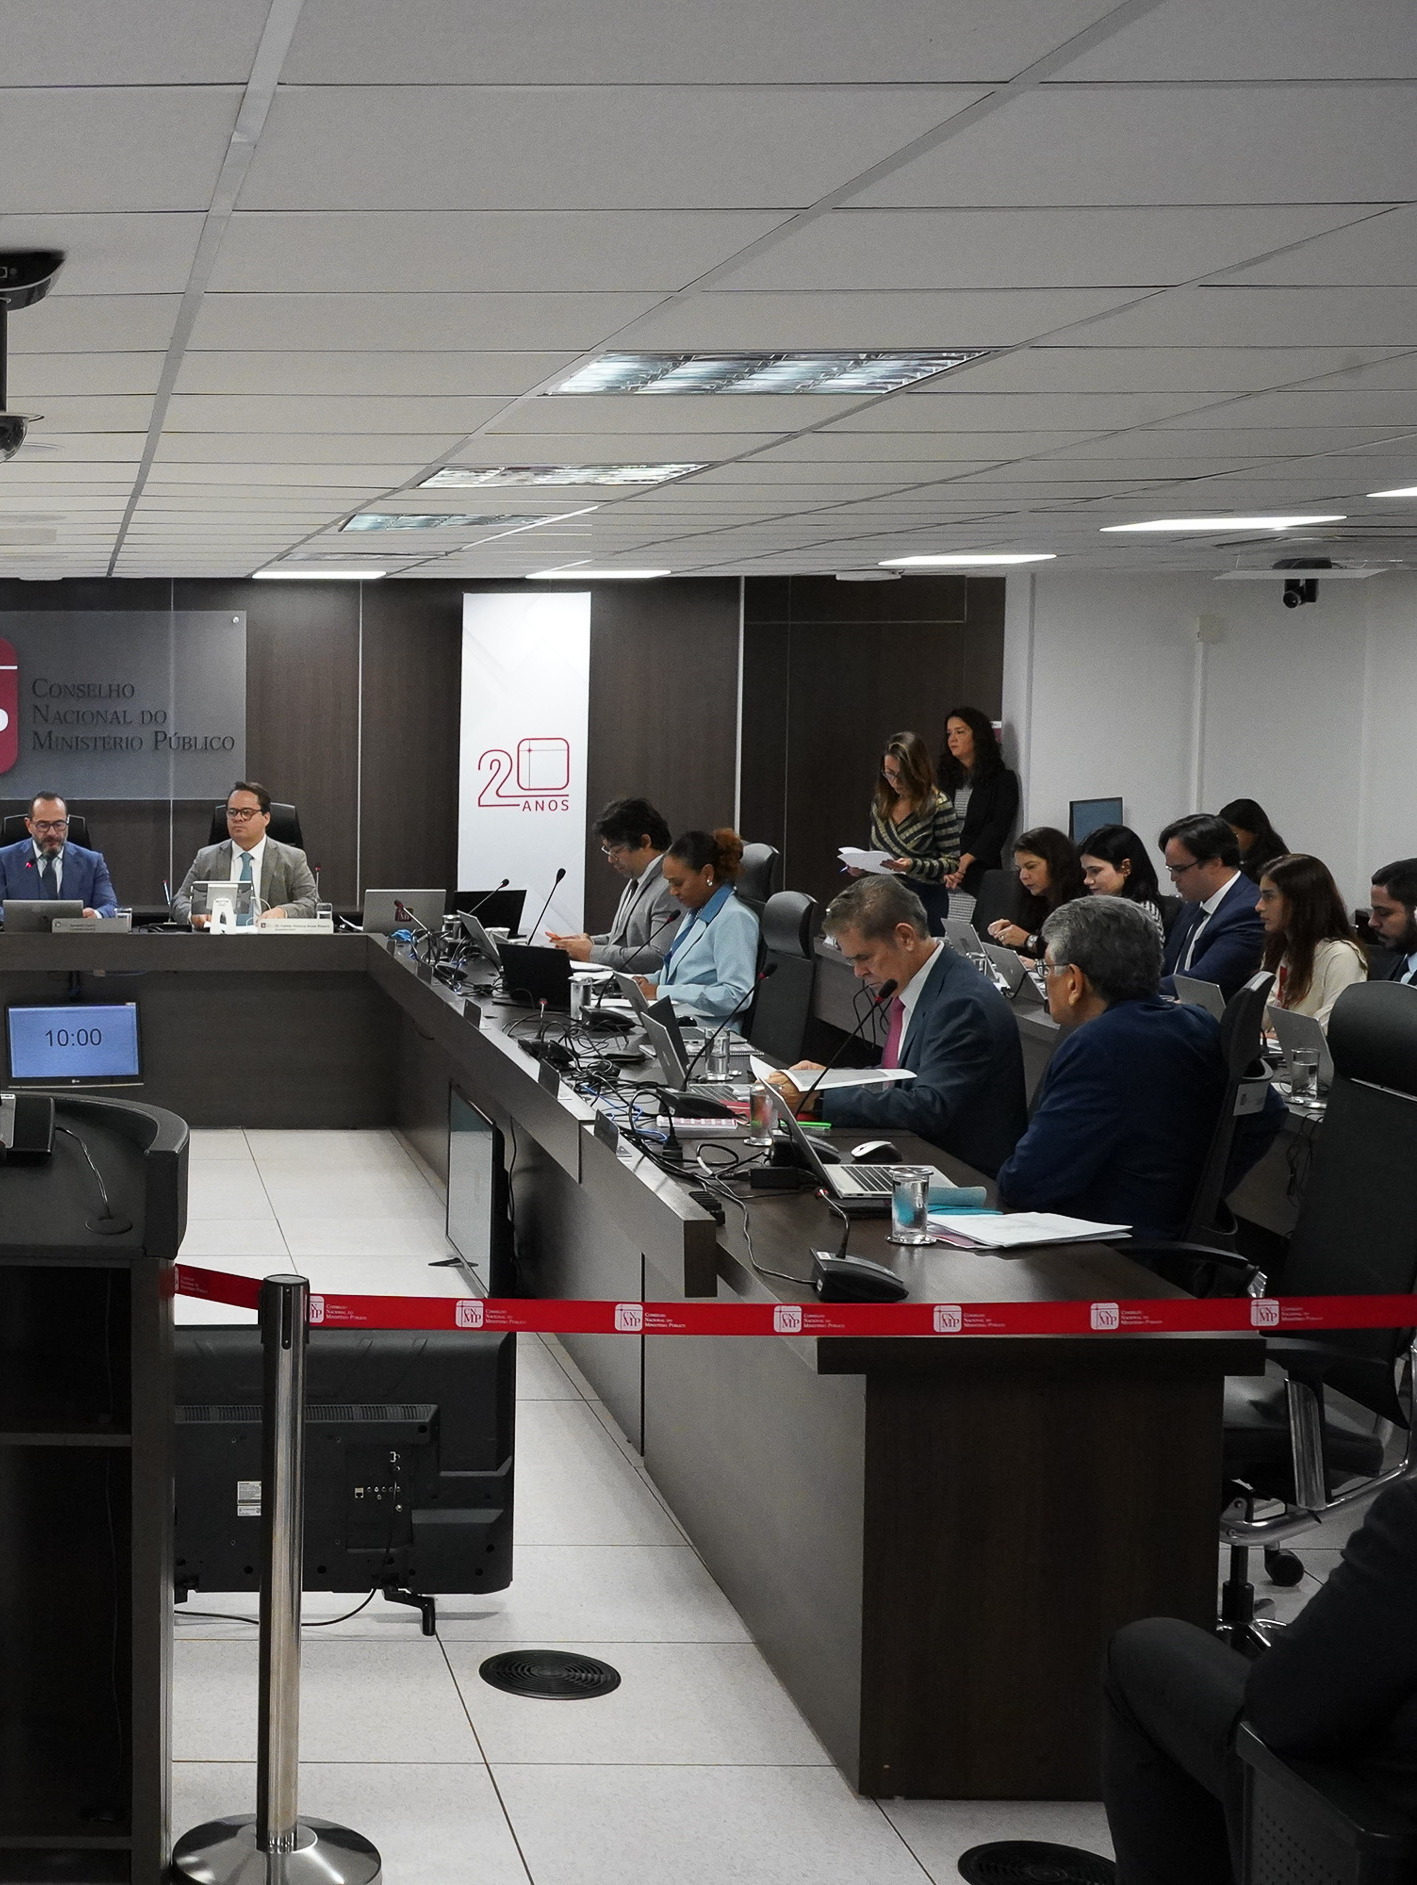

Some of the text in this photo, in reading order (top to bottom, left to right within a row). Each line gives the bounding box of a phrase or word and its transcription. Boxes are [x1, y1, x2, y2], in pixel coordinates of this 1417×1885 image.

[32, 677, 135, 699] CONSELHO
[32, 704, 168, 726] NACIONAL DO
[32, 730, 236, 751] MINISTÉRIO PÚBLICO
[522, 799, 569, 812] ANOS
[45, 1028, 102, 1047] 10:00
